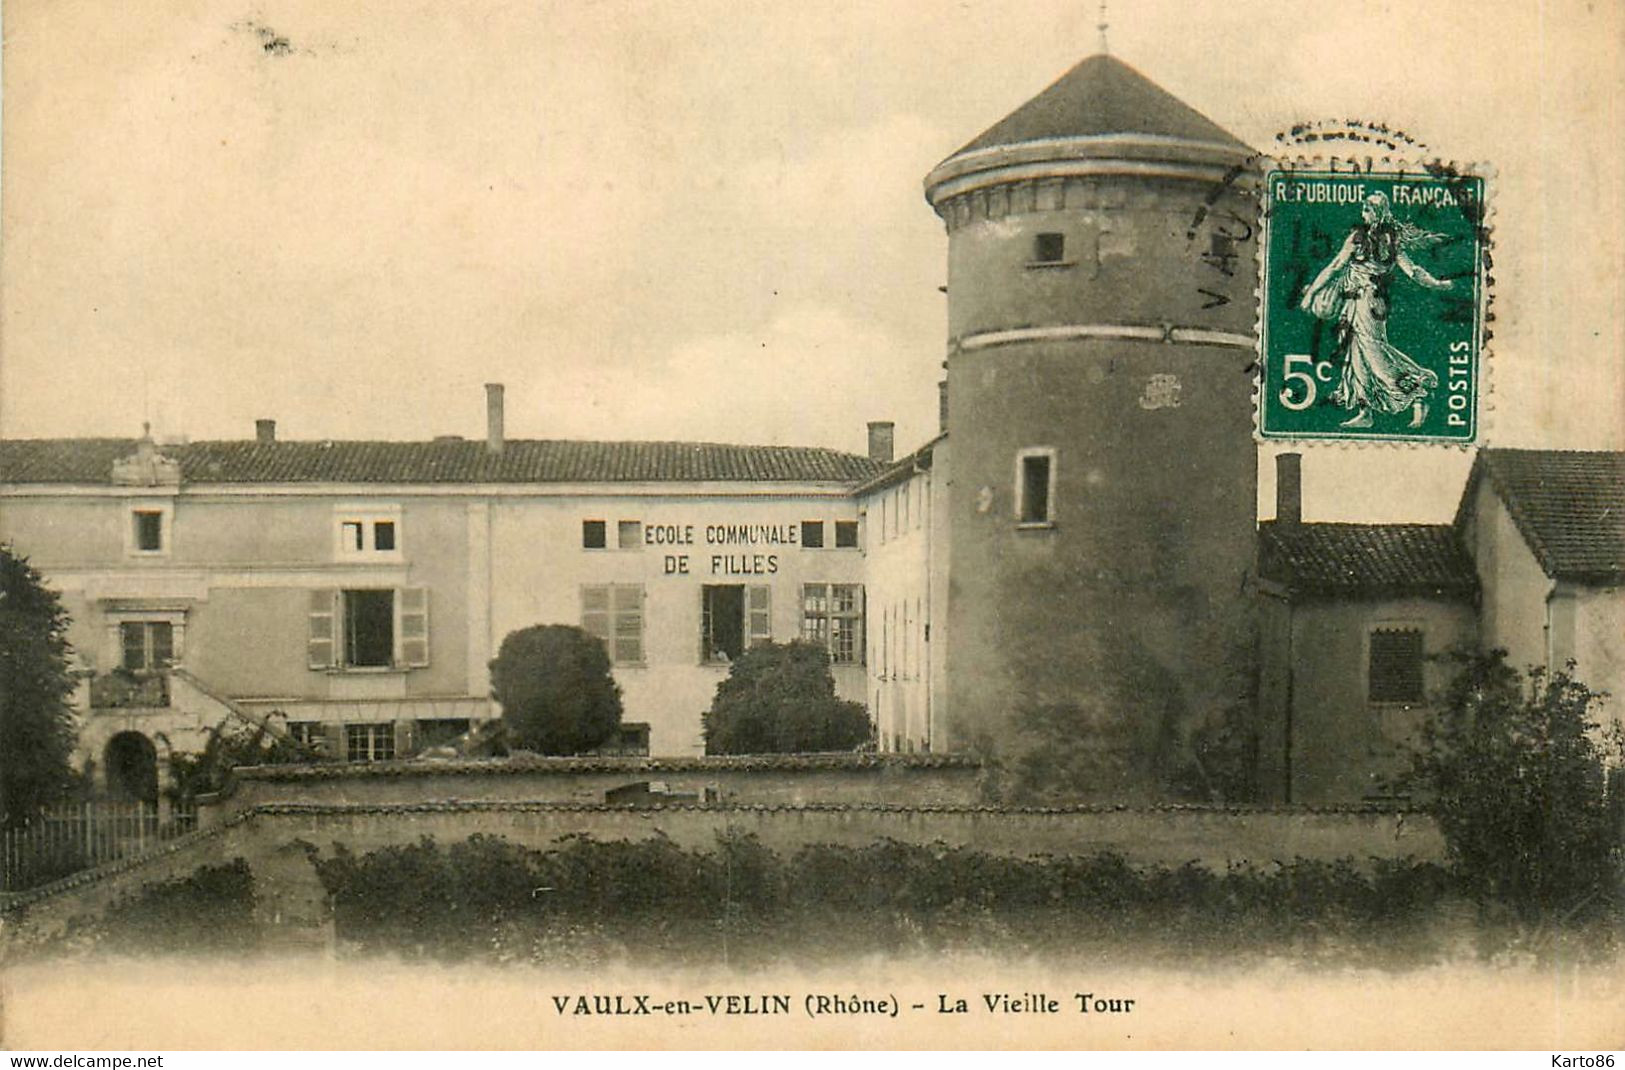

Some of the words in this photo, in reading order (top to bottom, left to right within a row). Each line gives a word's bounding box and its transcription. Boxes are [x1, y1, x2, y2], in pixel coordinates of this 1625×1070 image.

[1448, 341, 1469, 426] POSTES
[645, 525, 694, 545] ECOLE
[706, 525, 797, 545] COMMUNALE
[664, 555, 690, 575] DE
[711, 554, 778, 575] FILLES
